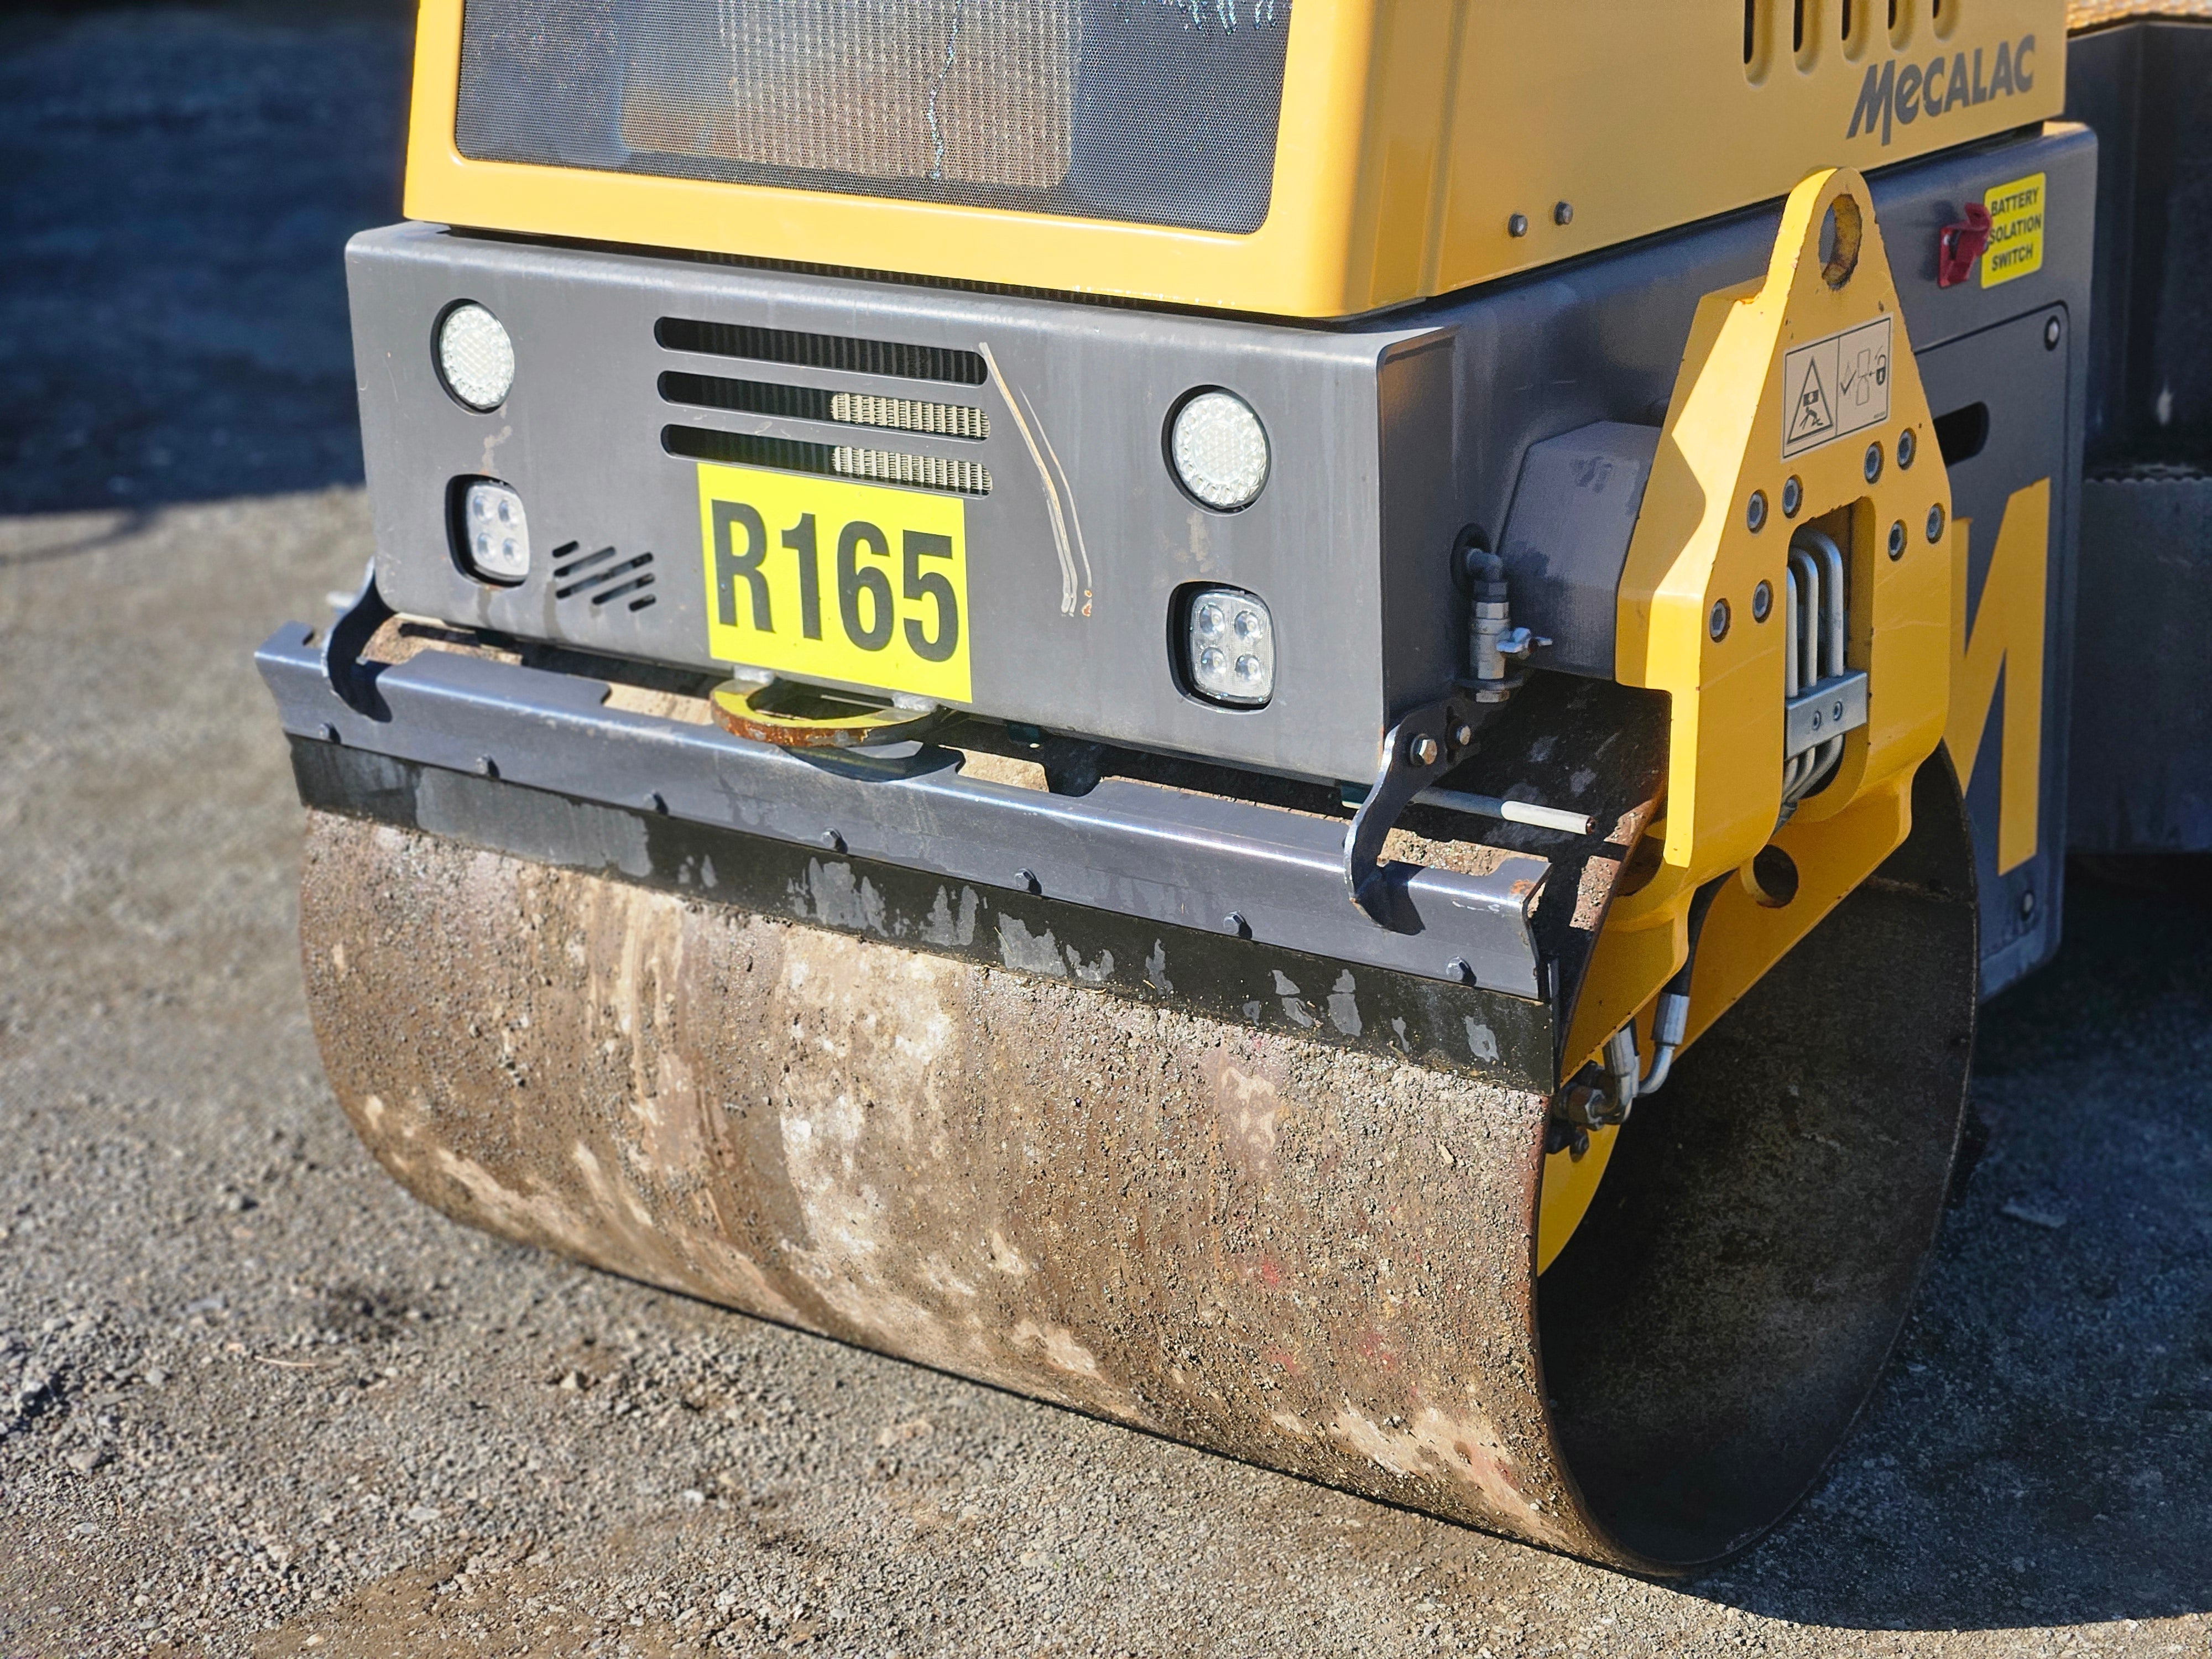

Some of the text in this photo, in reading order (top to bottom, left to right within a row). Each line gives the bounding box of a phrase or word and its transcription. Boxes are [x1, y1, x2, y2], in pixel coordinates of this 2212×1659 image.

[1991, 187, 2039, 216] BATTERY
[1990, 213, 2042, 245] SOLATION
[1992, 243, 2033, 272] SWITCH
[712, 499, 959, 662] R165
